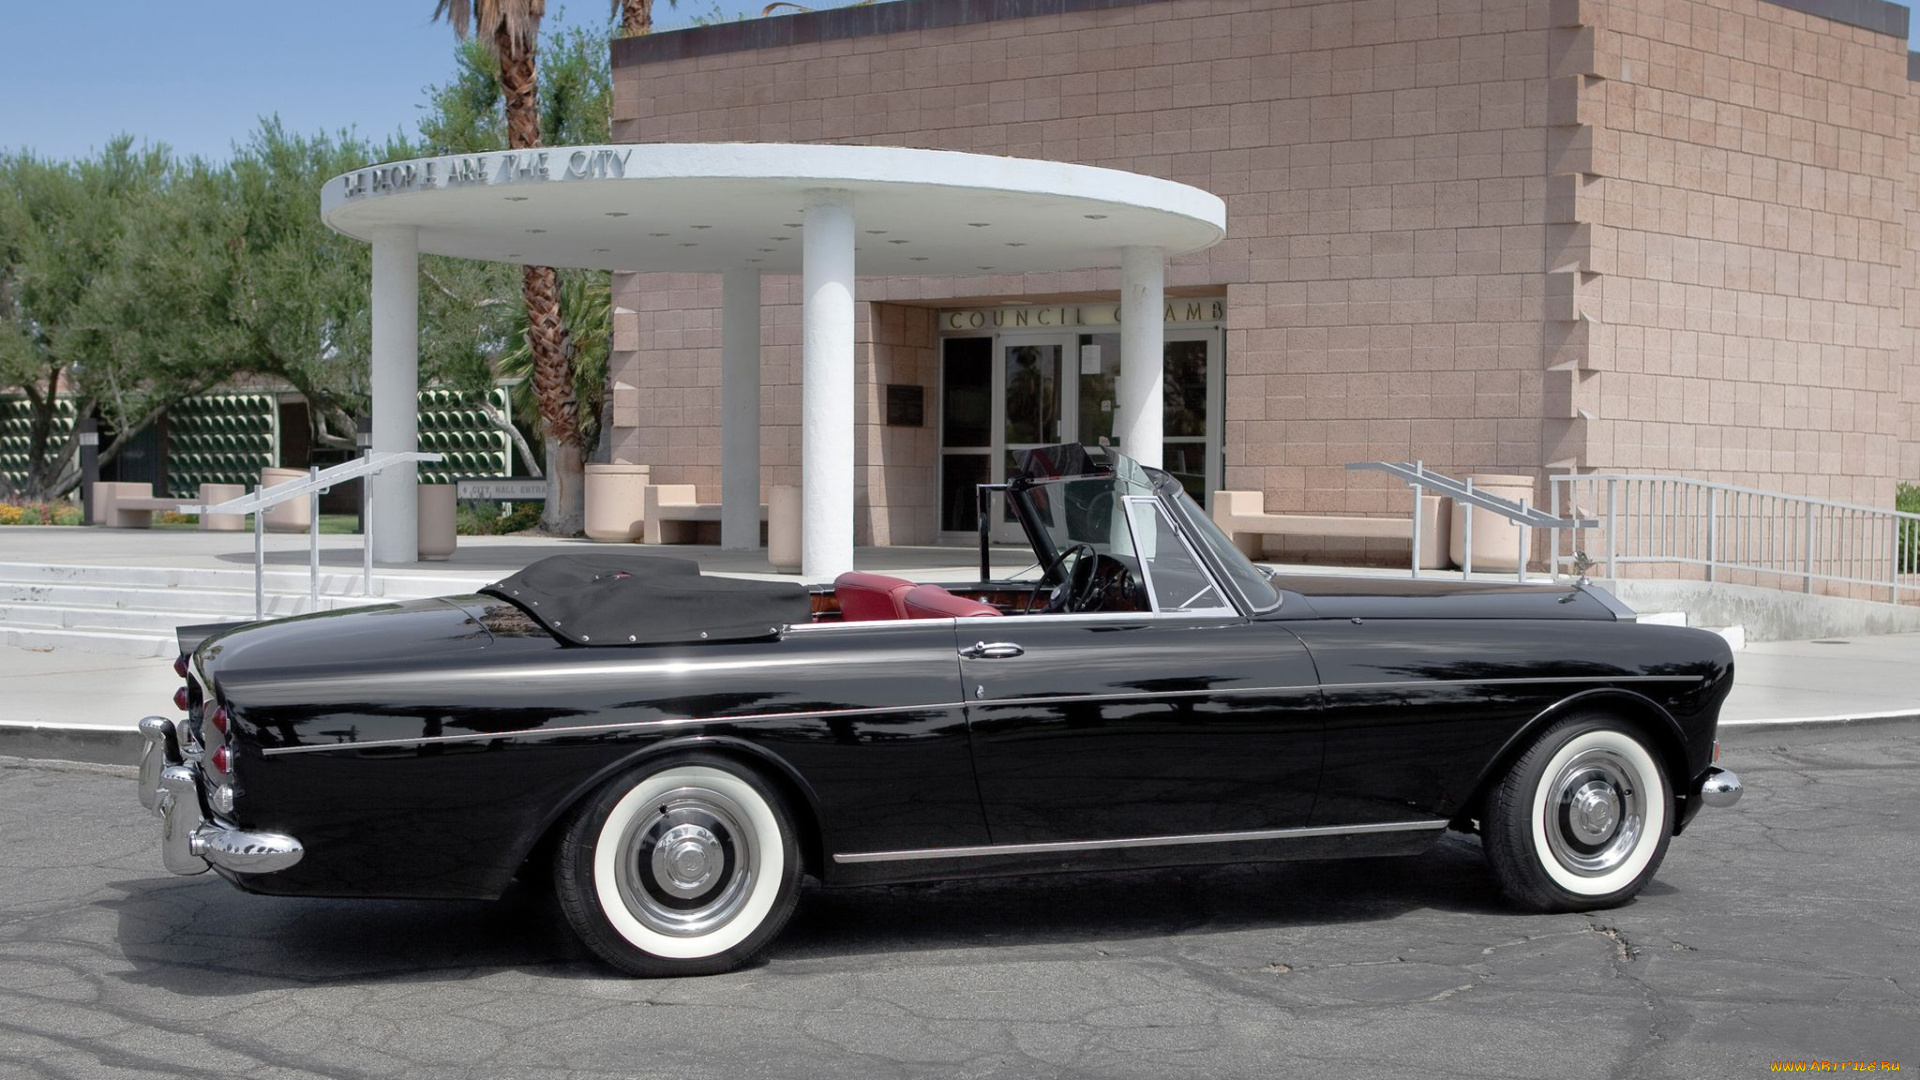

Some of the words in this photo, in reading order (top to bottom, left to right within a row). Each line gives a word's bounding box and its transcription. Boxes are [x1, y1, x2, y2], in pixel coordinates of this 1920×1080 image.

[448, 156, 488, 182] ARE
[503, 152, 550, 182] THE
[569, 148, 633, 178] CITY
[949, 308, 1086, 330] COUNCIL
[1113, 301, 1223, 323] CAMB
[471, 485, 490, 495] CITY
[495, 485, 516, 495] HALL
